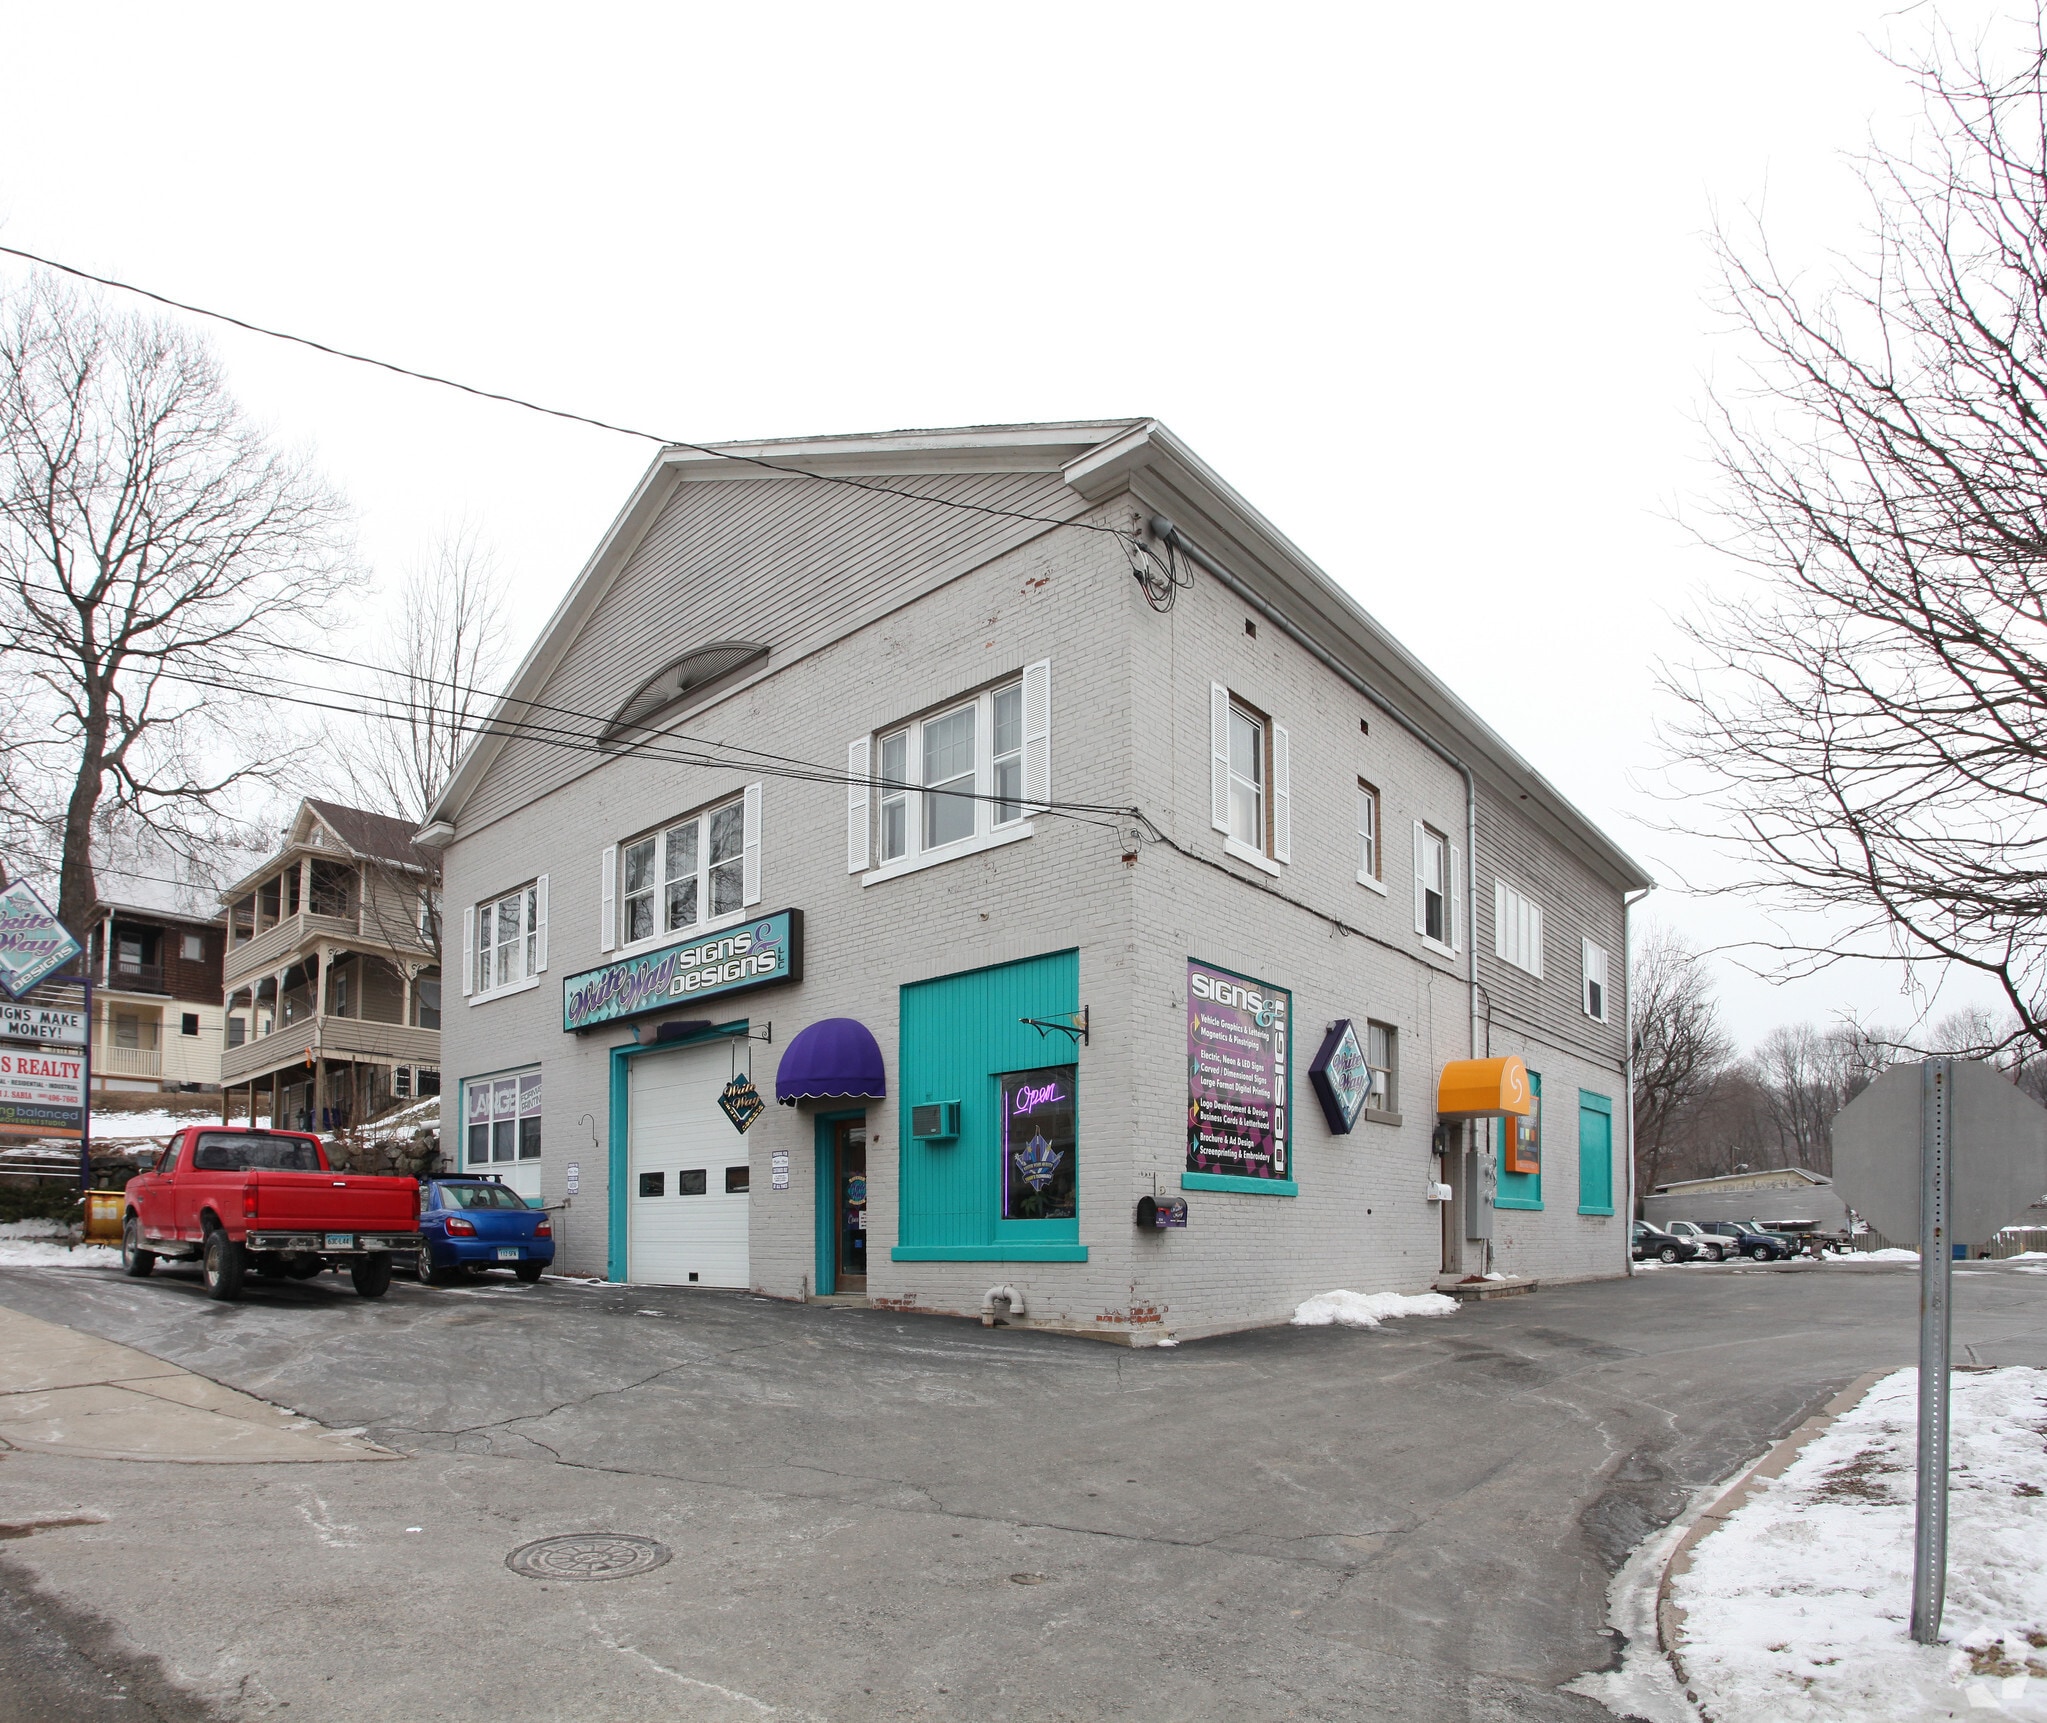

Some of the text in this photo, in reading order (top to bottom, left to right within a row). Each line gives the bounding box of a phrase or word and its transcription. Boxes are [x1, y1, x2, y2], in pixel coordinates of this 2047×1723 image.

[568, 951, 677, 1025] Write Way
[9, 1022, 62, 1039] MONEY!
[40, 1012, 78, 1027] MAKE
[1200, 1013, 1220, 1026] Vehicle
[1220, 1019, 1243, 1033] Graphics
[1248, 1027, 1270, 1042] Lettering
[1200, 1026, 1228, 1042] Magnetics
[1233, 1035, 1260, 1051] Pinstriping
[17, 1057, 81, 1079] REALTY
[1200, 1049, 1222, 1063] Electric,
[1222, 1054, 1236, 1066] Neon
[1241, 1059, 1251, 1069] LED
[1251, 1061, 1265, 1072] Signs
[1200, 1062, 1220, 1075] Carved
[1223, 1067, 1254, 1082] Dimensional
[1253, 1074, 1267, 1085] Signs
[11, 1079, 44, 1088] RESIDENTIAL
[48, 1082, 78, 1091] INDUSTRIAL
[11, 1090, 32, 1100] SABIA
[1200, 1075, 1271, 1099] Large Format Digital Printing
[1013, 1082, 1066, 1116] Open
[1200, 1097, 1213, 1110] Logo
[1213, 1100, 1247, 1114] Development
[1252, 1107, 1269, 1119] Design
[16, 1106, 79, 1120] balanced
[1200, 1111, 1222, 1123] Business
[1223, 1114, 1238, 1125] Cards
[1244, 1117, 1270, 1130] Letterhead
[1200, 1132, 1223, 1143] Brochure
[1229, 1136, 1236, 1145] Ad
[1237, 1137, 1255, 1149] Design
[1200, 1145, 1238, 1160] Screenprinting
[1243, 1150, 1271, 1163] Embroidery
